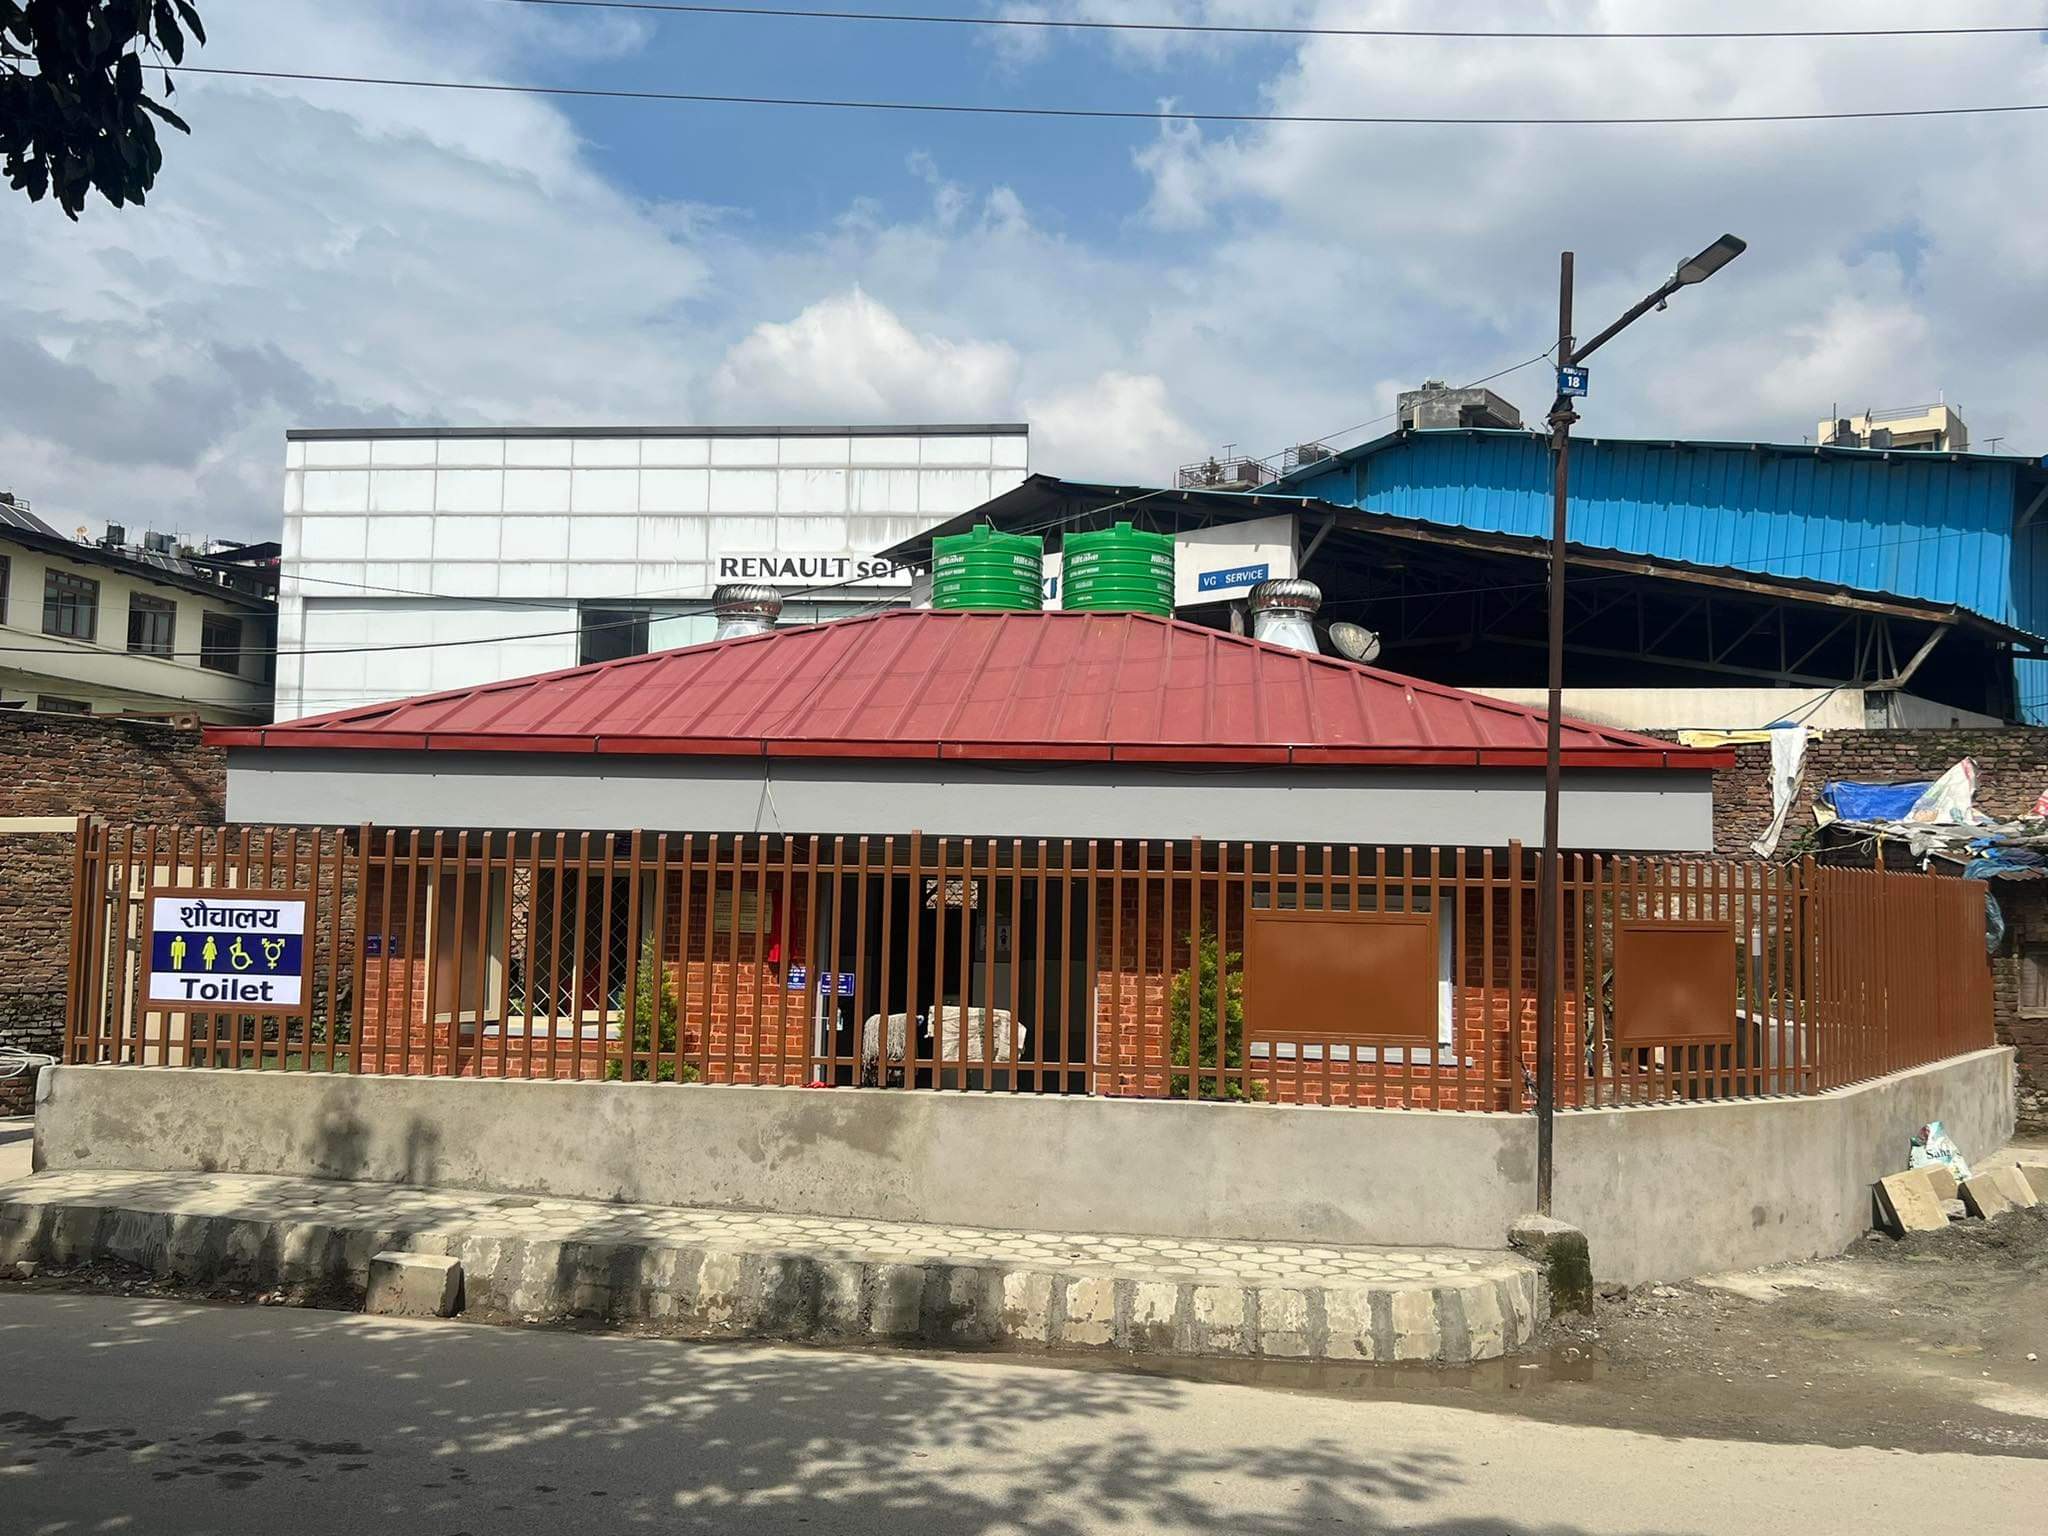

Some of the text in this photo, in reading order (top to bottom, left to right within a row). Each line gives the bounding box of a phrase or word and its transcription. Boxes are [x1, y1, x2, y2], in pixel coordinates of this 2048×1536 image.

[1567, 376, 1580, 388] 18
[720, 557, 850, 578] RENAULT
[1203, 569, 1263, 587] VG SERVICE
[180, 900, 281, 929] शौचालय
[180, 978, 274, 1002] Toilet
